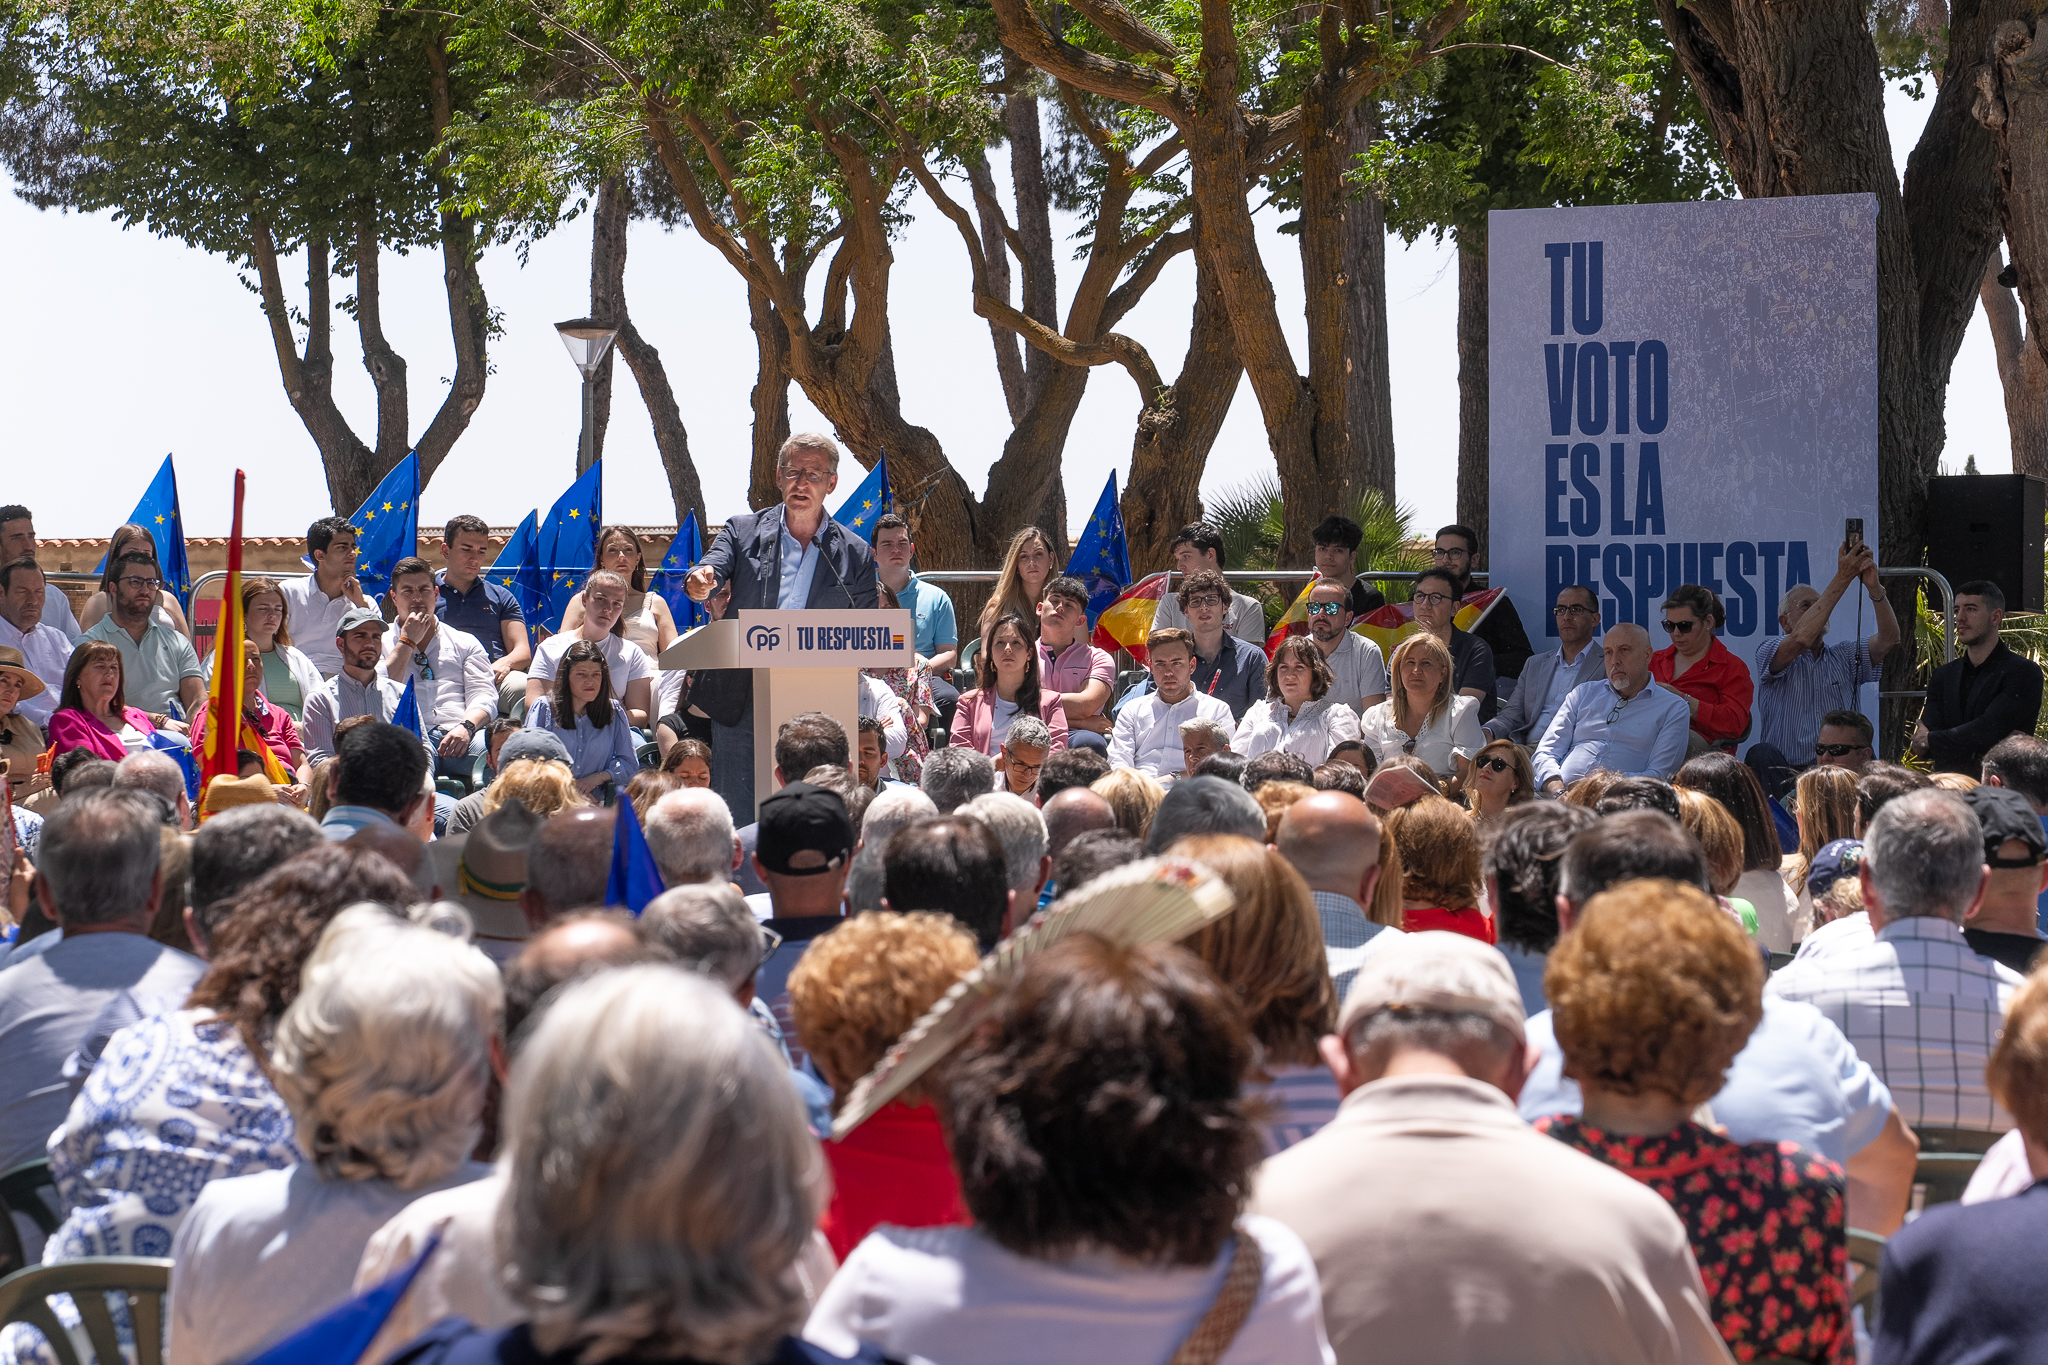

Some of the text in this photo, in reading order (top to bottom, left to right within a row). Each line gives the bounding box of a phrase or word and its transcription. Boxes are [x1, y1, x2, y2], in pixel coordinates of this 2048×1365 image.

[1545, 241, 1603, 335] TU
[1544, 340, 1668, 436] VOTO
[1545, 442, 1665, 537] ES LA
[797, 627, 891, 650] TU RESPUESTA
